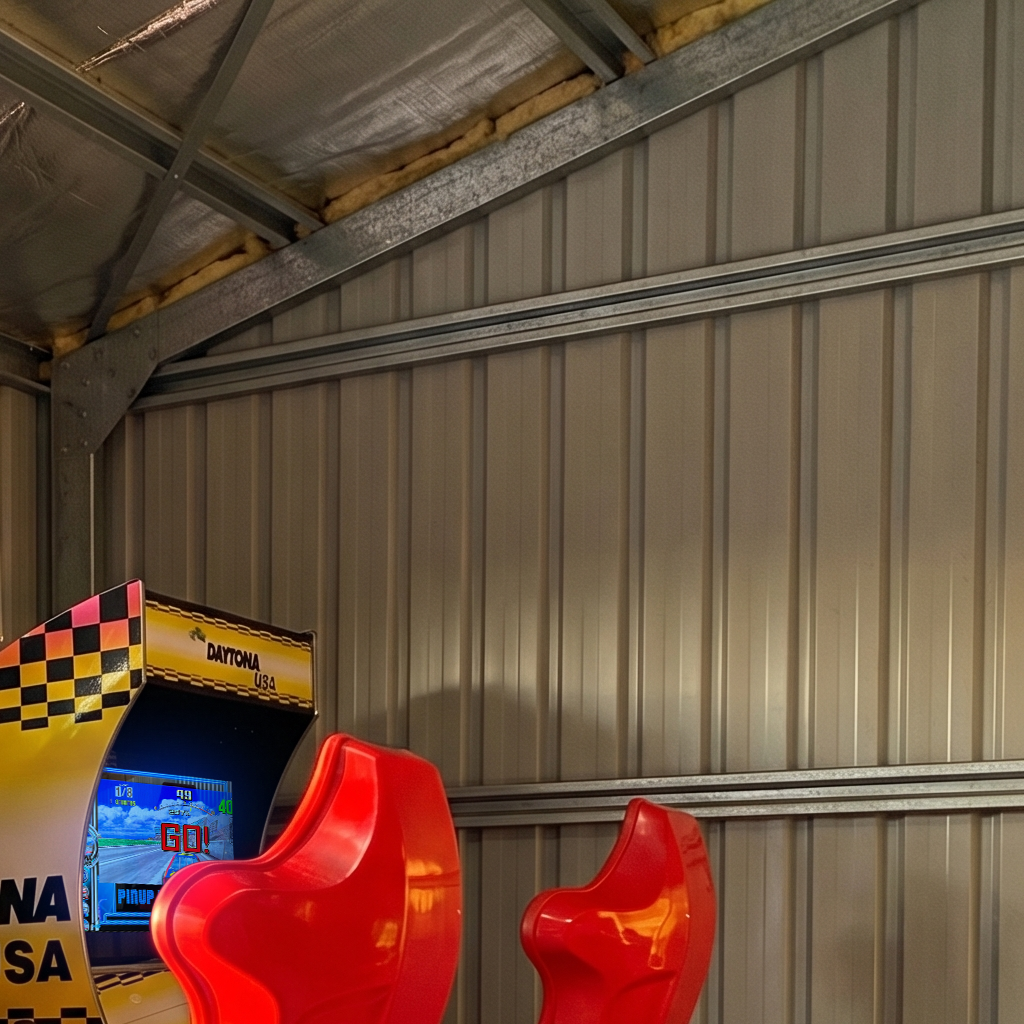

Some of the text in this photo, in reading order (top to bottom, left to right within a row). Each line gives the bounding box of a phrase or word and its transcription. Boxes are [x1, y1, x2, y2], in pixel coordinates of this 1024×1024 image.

[206, 642, 260, 671] DAYTONA
[218, 799, 233, 815] 40
[161, 823, 210, 855] GO!
